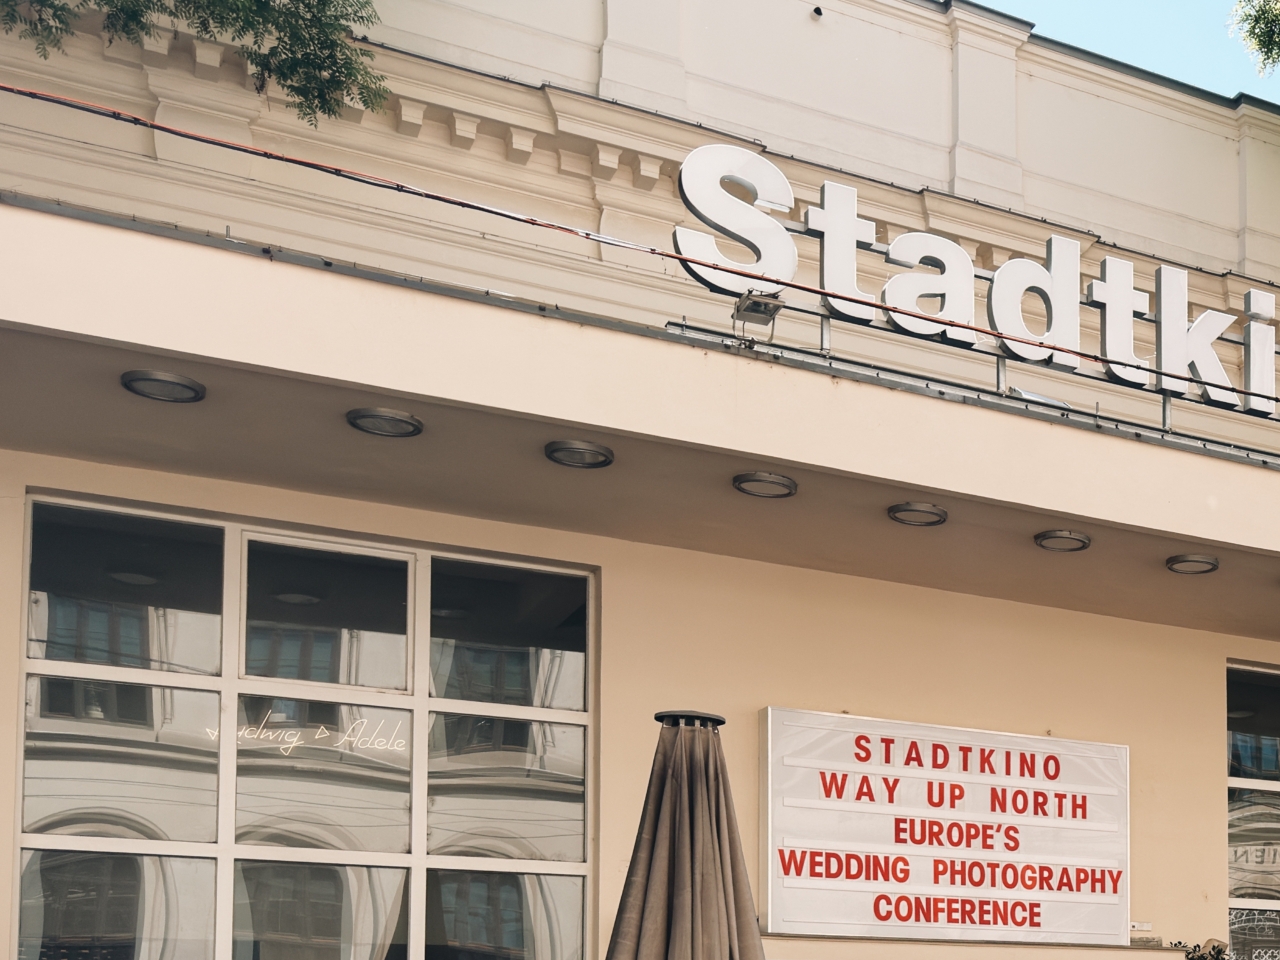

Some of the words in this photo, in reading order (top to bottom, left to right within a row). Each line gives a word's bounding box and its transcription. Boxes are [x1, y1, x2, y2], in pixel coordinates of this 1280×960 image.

[333, 718, 406, 752] Adele
[853, 734, 1061, 781] STADTKINO
[819, 770, 900, 805] WAY
[926, 780, 966, 810] UP
[989, 786, 1088, 820] NORTH
[777, 848, 911, 884] WEDDING
[932, 858, 1123, 895] PHOTOGRAPHY
[872, 893, 1042, 928] CONFERENCE
